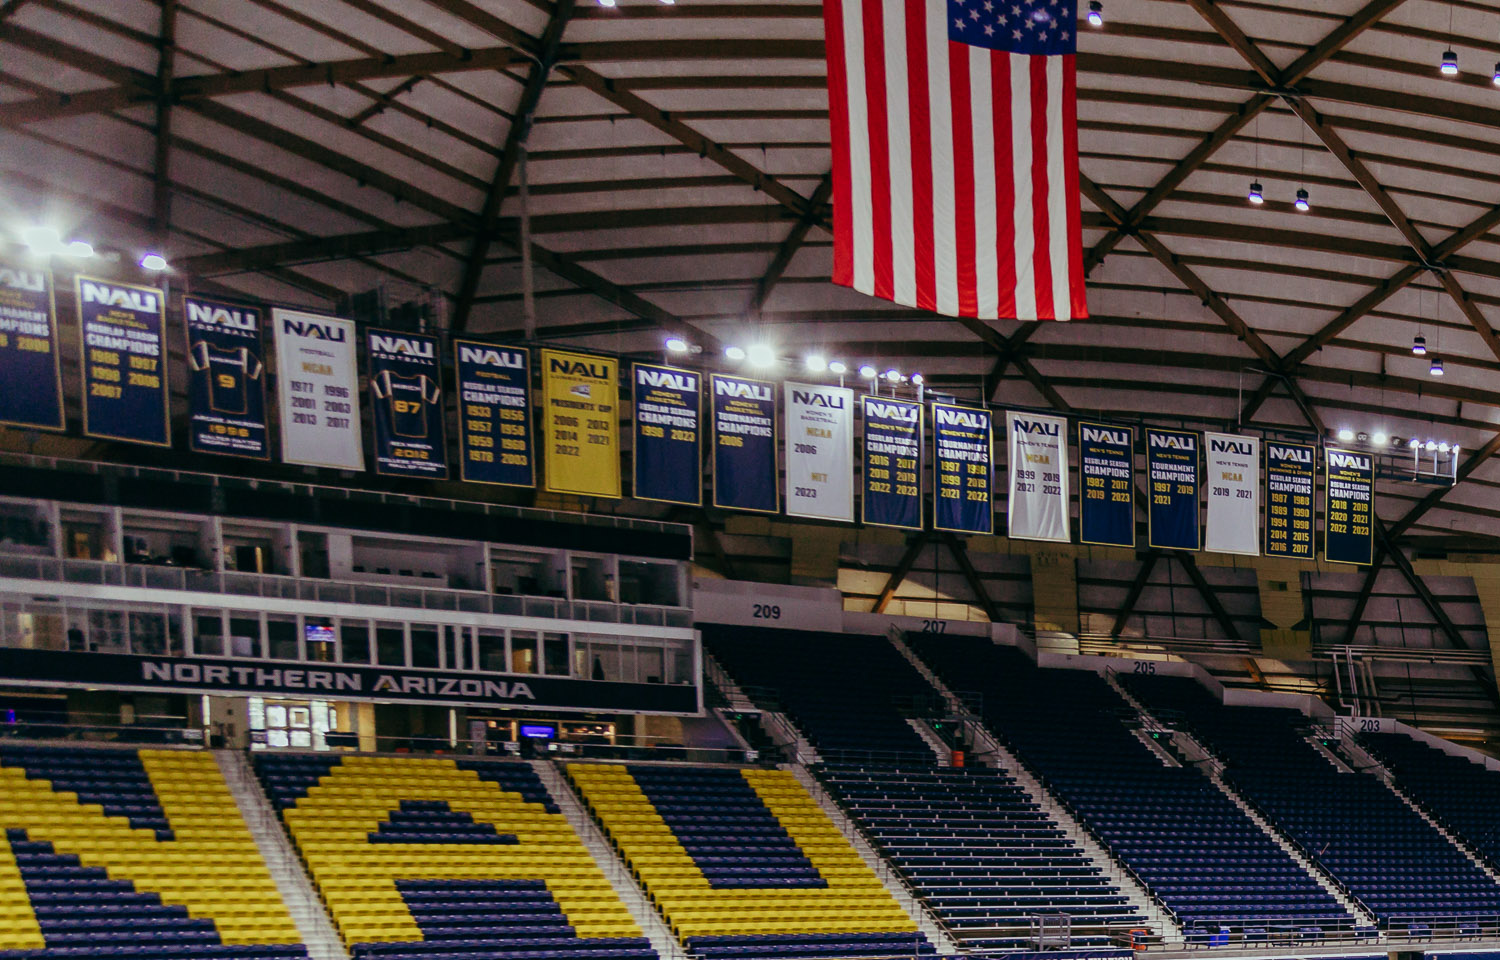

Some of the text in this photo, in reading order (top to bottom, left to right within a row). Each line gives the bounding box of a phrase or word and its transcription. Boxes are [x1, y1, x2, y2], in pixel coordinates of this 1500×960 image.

[81, 282, 160, 313] NAU
[187, 302, 257, 331] NAU
[283, 319, 346, 343] NAU
[87, 333, 159, 356] CHAMPIONS
[371, 335, 434, 358] NAU
[460, 347, 525, 369] NAU
[551, 358, 609, 379] NAU
[217, 374, 236, 389] 9
[637, 370, 697, 392] NAU
[715, 380, 772, 401] NAU
[463, 391, 526, 407] CHAMPIONS
[792, 390, 844, 409] NAU
[395, 400, 421, 414] 87
[866, 402, 919, 423] NAU
[638, 412, 697, 428] CHAMPIONS
[937, 409, 987, 429] NAU
[717, 421, 772, 437] CHAMPIONS
[1014, 420, 1059, 437] NAU
[1083, 427, 1129, 446] NAU
[1150, 434, 1195, 451] NAU
[794, 443, 817, 455] 2006
[867, 441, 918, 457] CHAMPIONS
[938, 439, 988, 452] TOURNAMENT
[1211, 440, 1252, 455] NAU
[938, 448, 988, 463] CHAMPIONS
[1269, 446, 1312, 463] NAU
[1329, 454, 1370, 470] NAU
[940, 461, 960, 472] 1997
[1084, 465, 1130, 479] CHAMPIONS
[1152, 462, 1194, 473] TOURNAMENT
[1017, 470, 1060, 483] 1999 2019
[1151, 470, 1195, 483] CHAMPIONS
[795, 487, 817, 498] 2023
[896, 484, 918, 496] 2023
[1017, 482, 1061, 495] 2021 2022
[1111, 480, 1128, 490] 2017
[1154, 482, 1194, 495] 1997 2019
[1270, 481, 1311, 494] CHAMPIONS
[940, 487, 988, 502] 2021 2022
[1111, 492, 1130, 503] 2023
[1154, 495, 1171, 505] 2021
[1213, 487, 1252, 499] 2019 2021
[1330, 488, 1370, 501] CHAMPIONS
[1331, 500, 1368, 512] 2018 2019
[1331, 511, 1368, 524] 2020 2021
[1270, 530, 1309, 542] 2014 2015
[1330, 523, 1369, 536] 2022 2023
[1270, 542, 1309, 554] 2016 2017
[752, 604, 781, 619] 209
[922, 620, 946, 634] 207
[1134, 661, 1155, 675] 205
[141, 661, 536, 700] NORTHERN ARIZONA
[1360, 720, 1379, 732] 203
